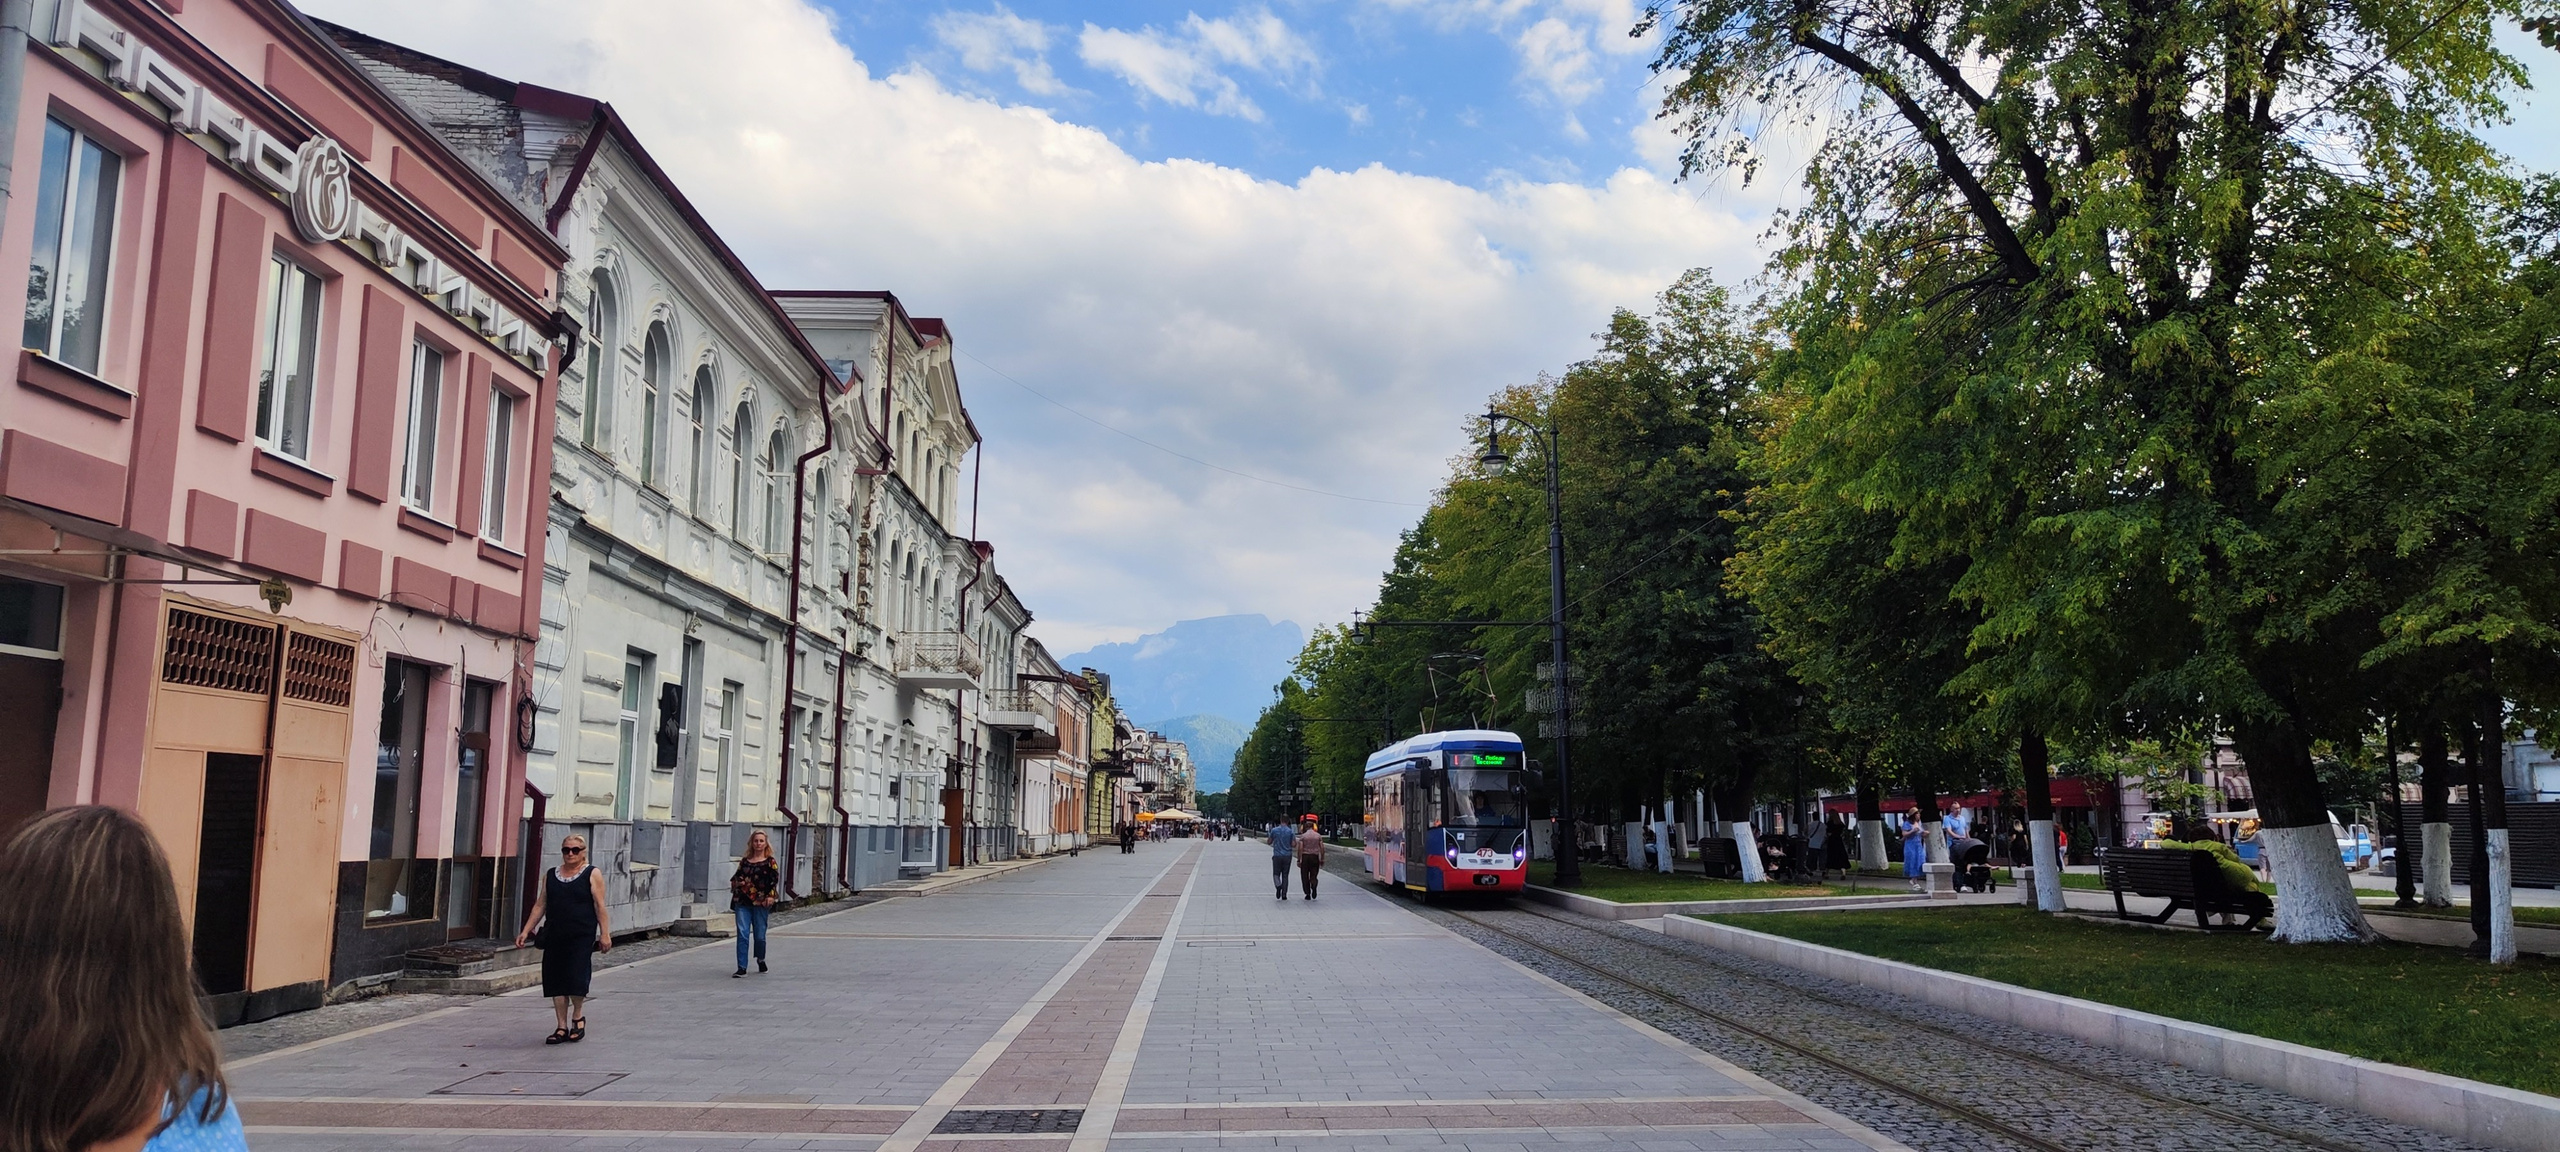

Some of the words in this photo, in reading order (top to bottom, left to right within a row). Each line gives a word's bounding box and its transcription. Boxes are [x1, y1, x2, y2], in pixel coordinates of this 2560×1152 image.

[53, 0, 300, 193] НАНО
[346, 199, 552, 371] КЛИНИК
[1476, 848, 1493, 858] 473
